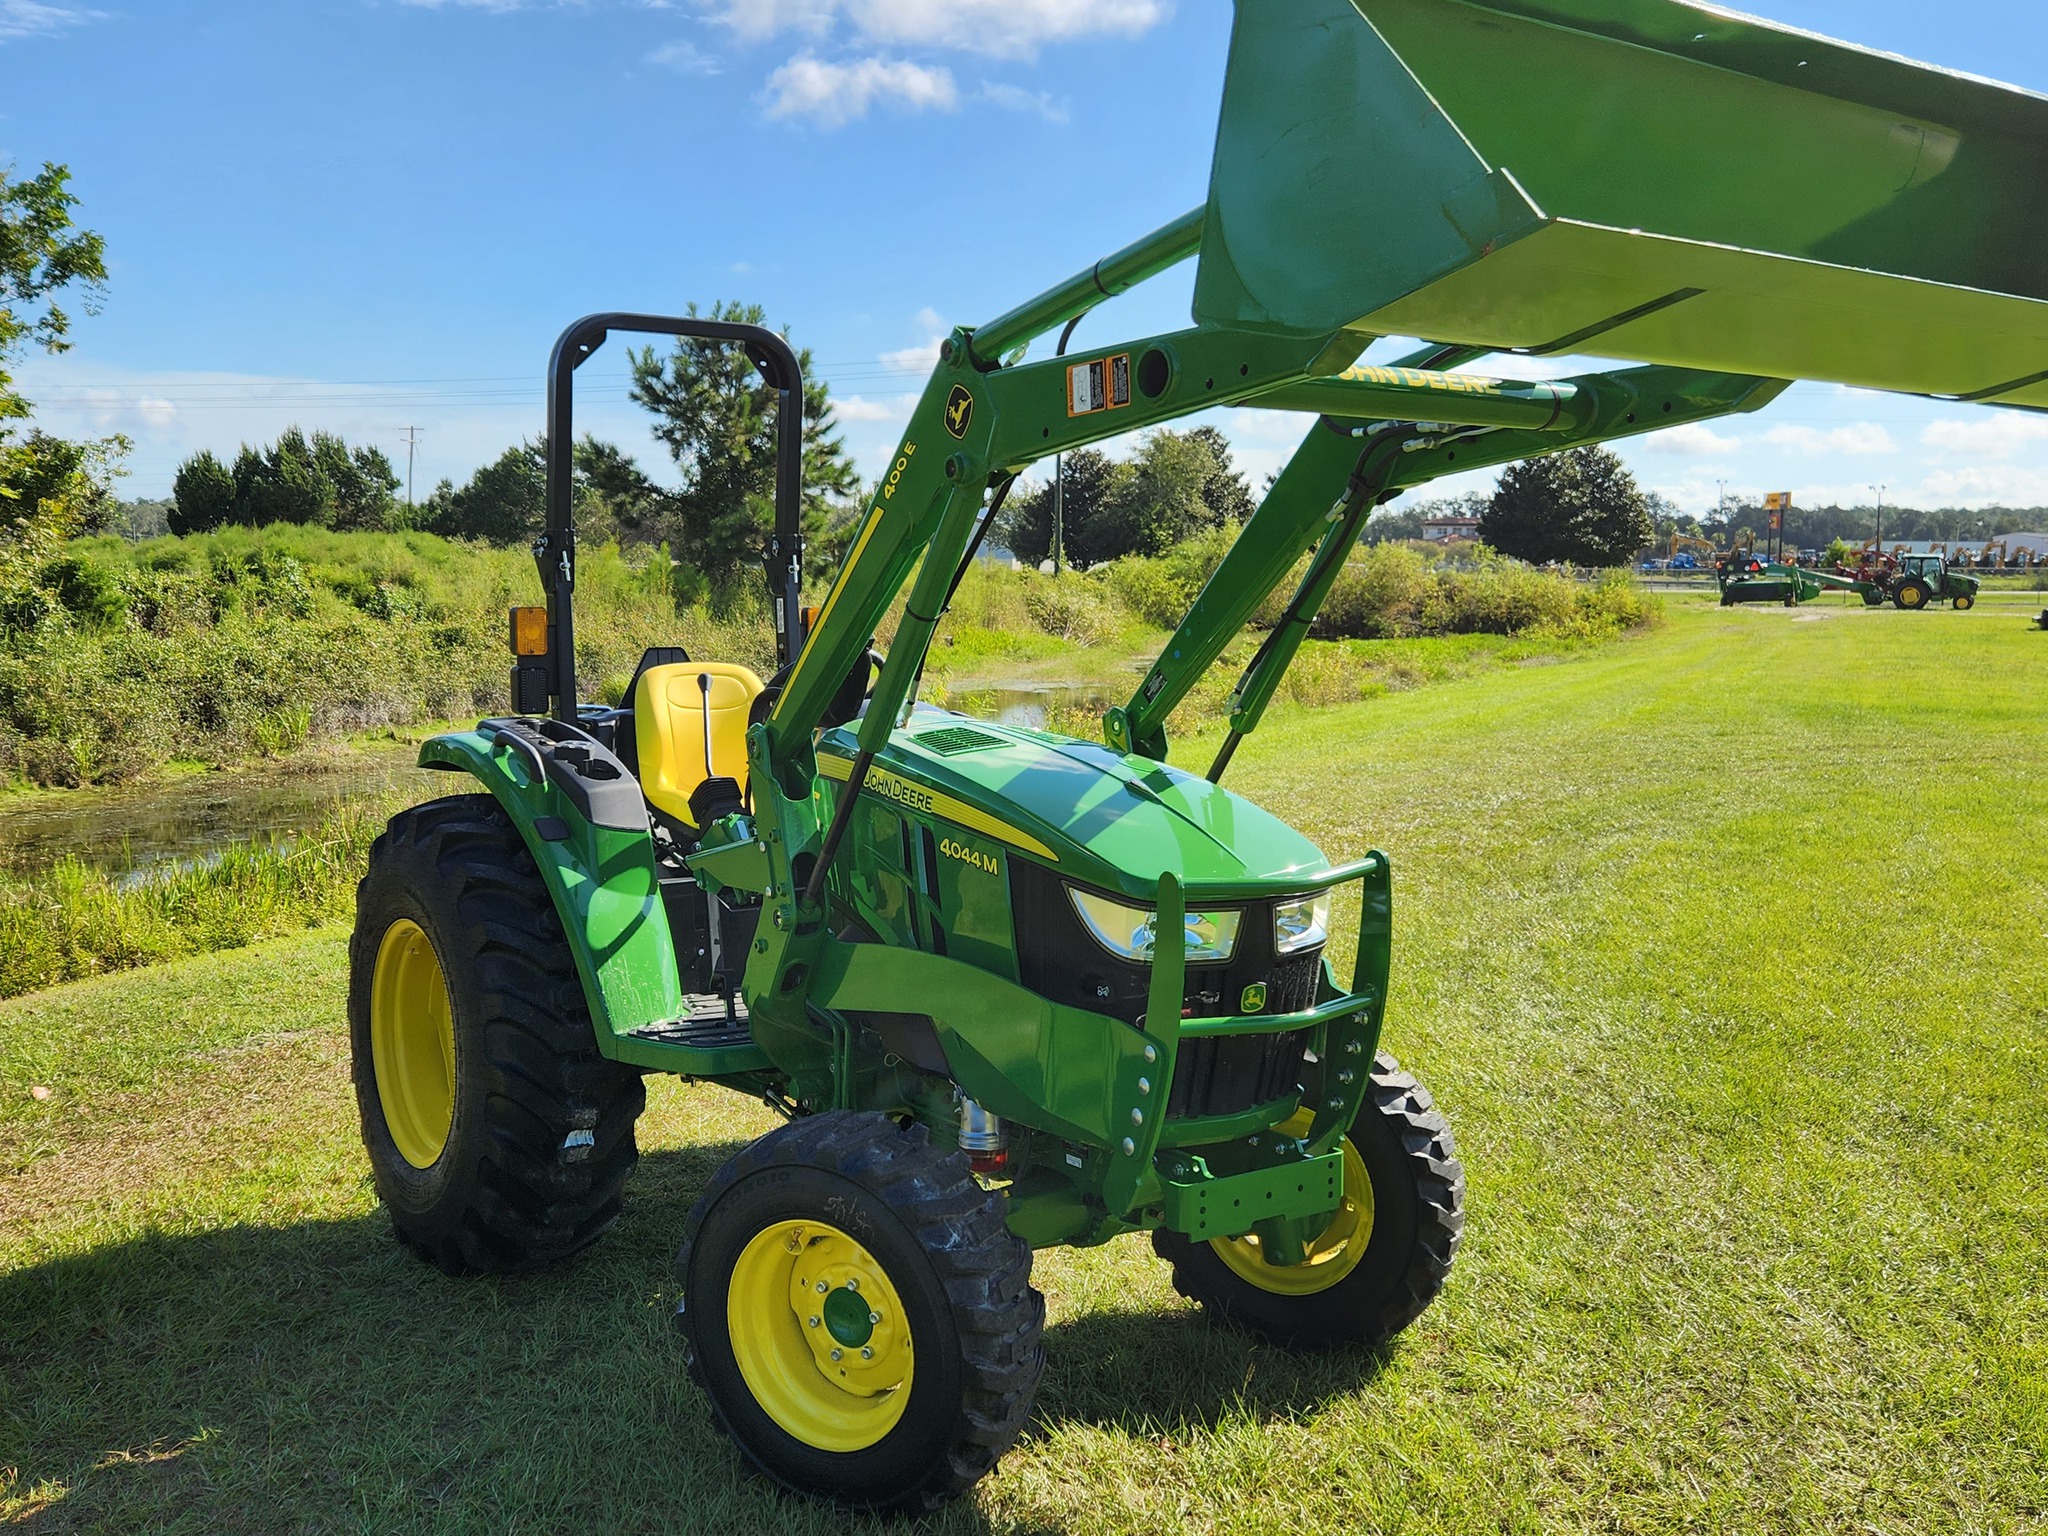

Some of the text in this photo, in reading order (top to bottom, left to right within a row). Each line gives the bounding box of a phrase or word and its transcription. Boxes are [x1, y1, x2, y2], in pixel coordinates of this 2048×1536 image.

[1337, 364, 1502, 395] OHN DEERE
[863, 769, 934, 812] JOHN DEERE
